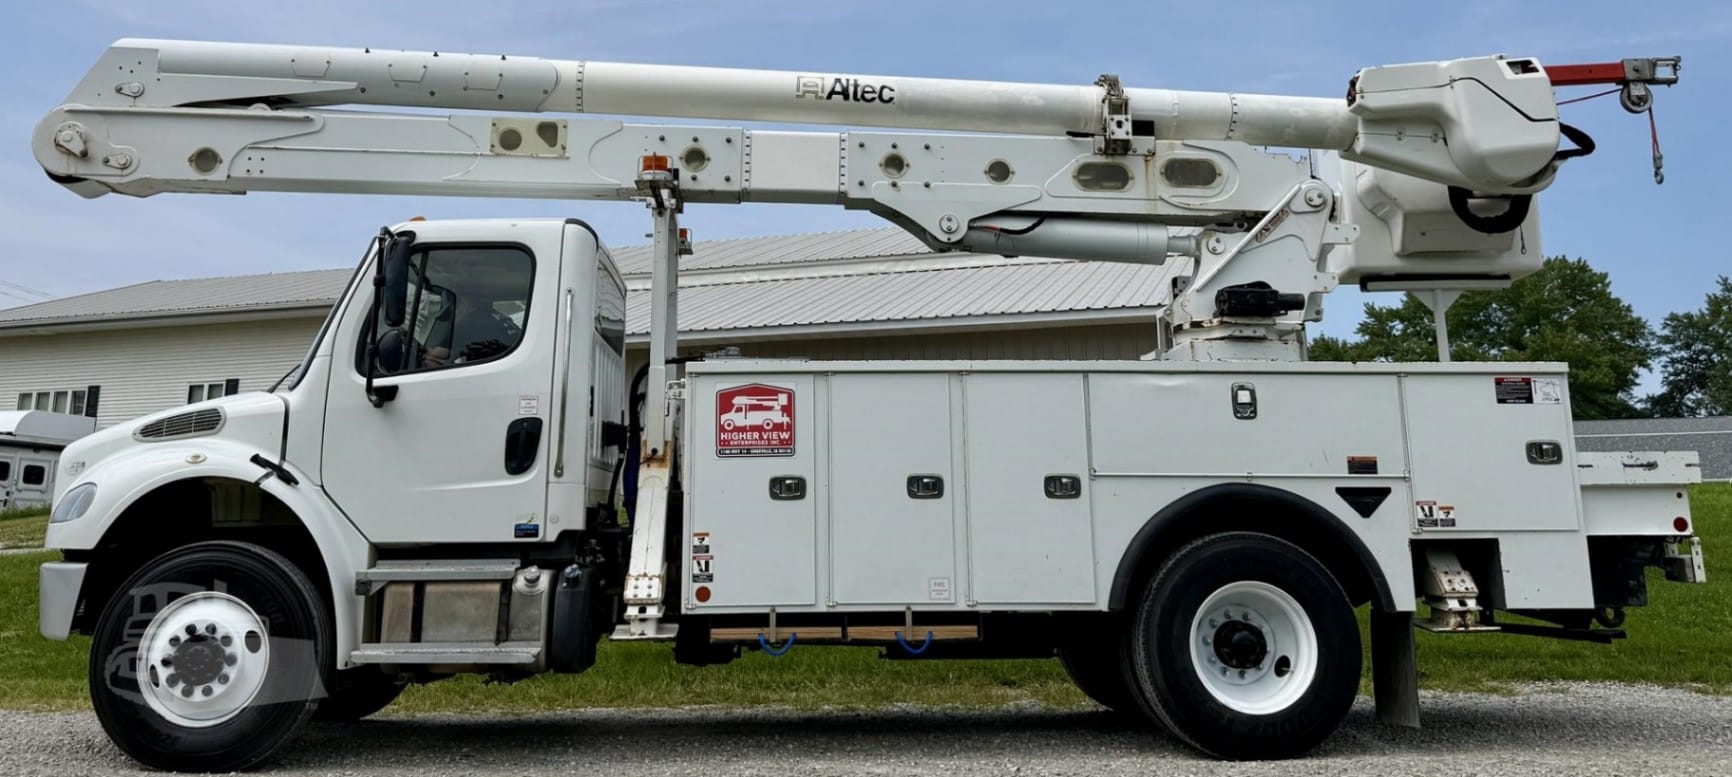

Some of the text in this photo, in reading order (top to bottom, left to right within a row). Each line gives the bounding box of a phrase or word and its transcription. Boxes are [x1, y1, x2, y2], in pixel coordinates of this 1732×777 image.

[826, 78, 895, 104] Altec
[720, 431, 790, 440] HIGHER VIEW
